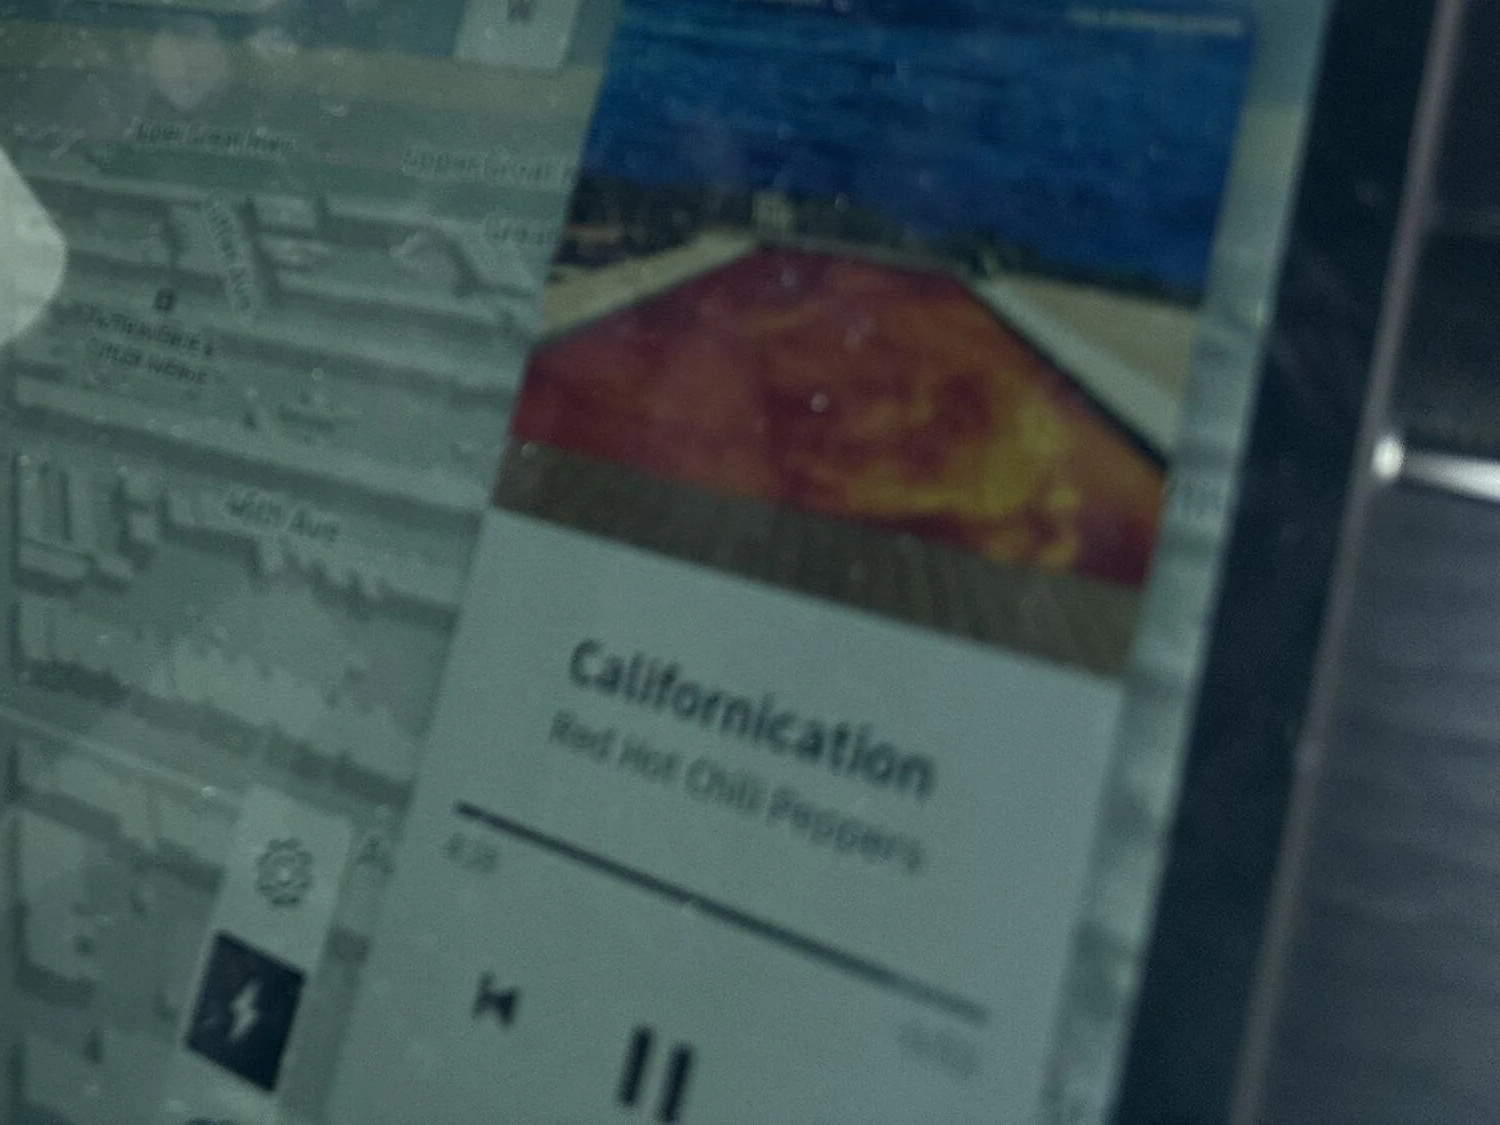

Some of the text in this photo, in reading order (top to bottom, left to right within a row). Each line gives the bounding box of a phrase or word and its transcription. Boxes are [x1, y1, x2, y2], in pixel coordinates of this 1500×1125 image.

[549, 709, 926, 878] Red Hot Chili Peppers
[567, 636, 938, 800] Californication
